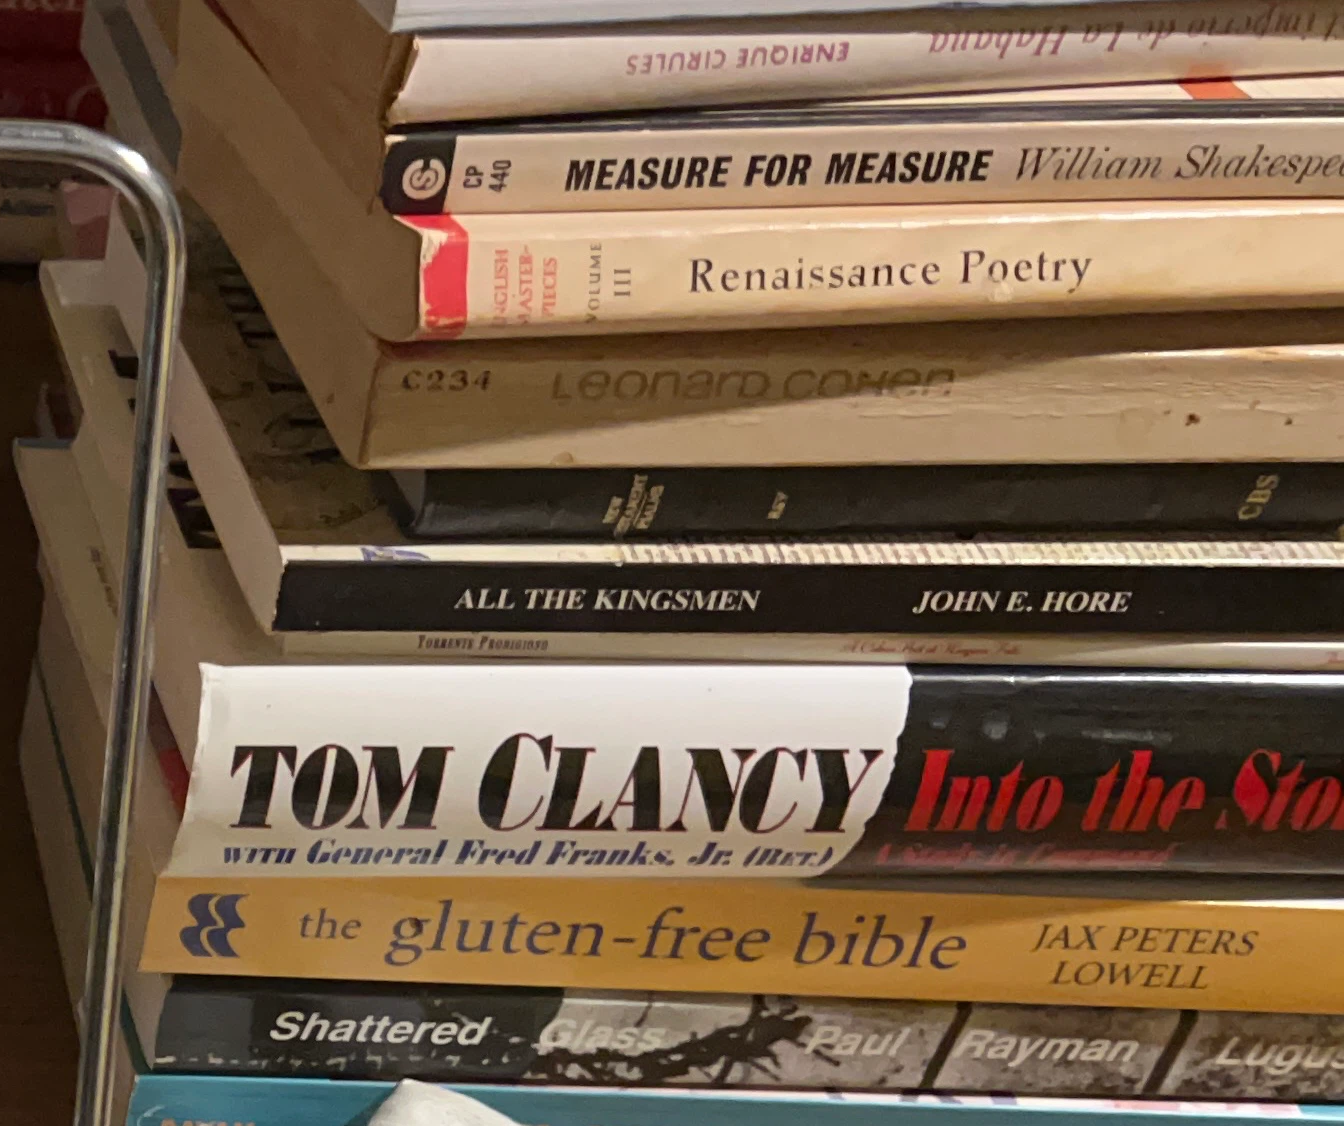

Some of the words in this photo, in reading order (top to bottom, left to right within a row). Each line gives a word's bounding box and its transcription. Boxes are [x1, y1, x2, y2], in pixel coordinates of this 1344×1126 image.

[928, 24, 1069, 61] Habana
[1082, 21, 1123, 54] La
[1139, 17, 1176, 50] de
[626, 49, 726, 76] CIRULES
[736, 41, 850, 70] ENRIQUE
[463, 164, 485, 190] CP
[490, 159, 513, 194] 440
[565, 155, 732, 192] MEASURE
[744, 153, 812, 188] FOR
[825, 149, 994, 185] MEASURE
[1016, 145, 1161, 182] William
[585, 243, 602, 323] VOLUME
[689, 256, 942, 295] Renaissance
[959, 250, 1092, 294] Poetry
[401, 370, 491, 391] C234
[454, 588, 516, 611] ALL
[524, 588, 585, 611] THE
[593, 588, 761, 613] KINGSMEN
[913, 590, 1001, 614] JOHN
[1006, 591, 1032, 613] E.
[1040, 590, 1132, 614] HORE
[229, 743, 456, 831] TOM
[478, 731, 884, 834] CLANCY
[903, 747, 1066, 834] Into
[1081, 748, 1207, 833] the
[306, 838, 445, 866] General
[454, 838, 544, 867] Fred
[688, 840, 735, 867] Jr.
[299, 908, 363, 940] the
[382, 898, 771, 967] gluten-free
[793, 911, 969, 971] bible
[1031, 923, 1104, 955] JAX
[1113, 925, 1260, 957] PETERS
[1052, 961, 1211, 991] LOWELL
[268, 1010, 494, 1047] Shattered
[537, 1019, 669, 1052] Glass
[805, 1025, 913, 1058] Paul
[953, 1028, 1142, 1068] Rayman
